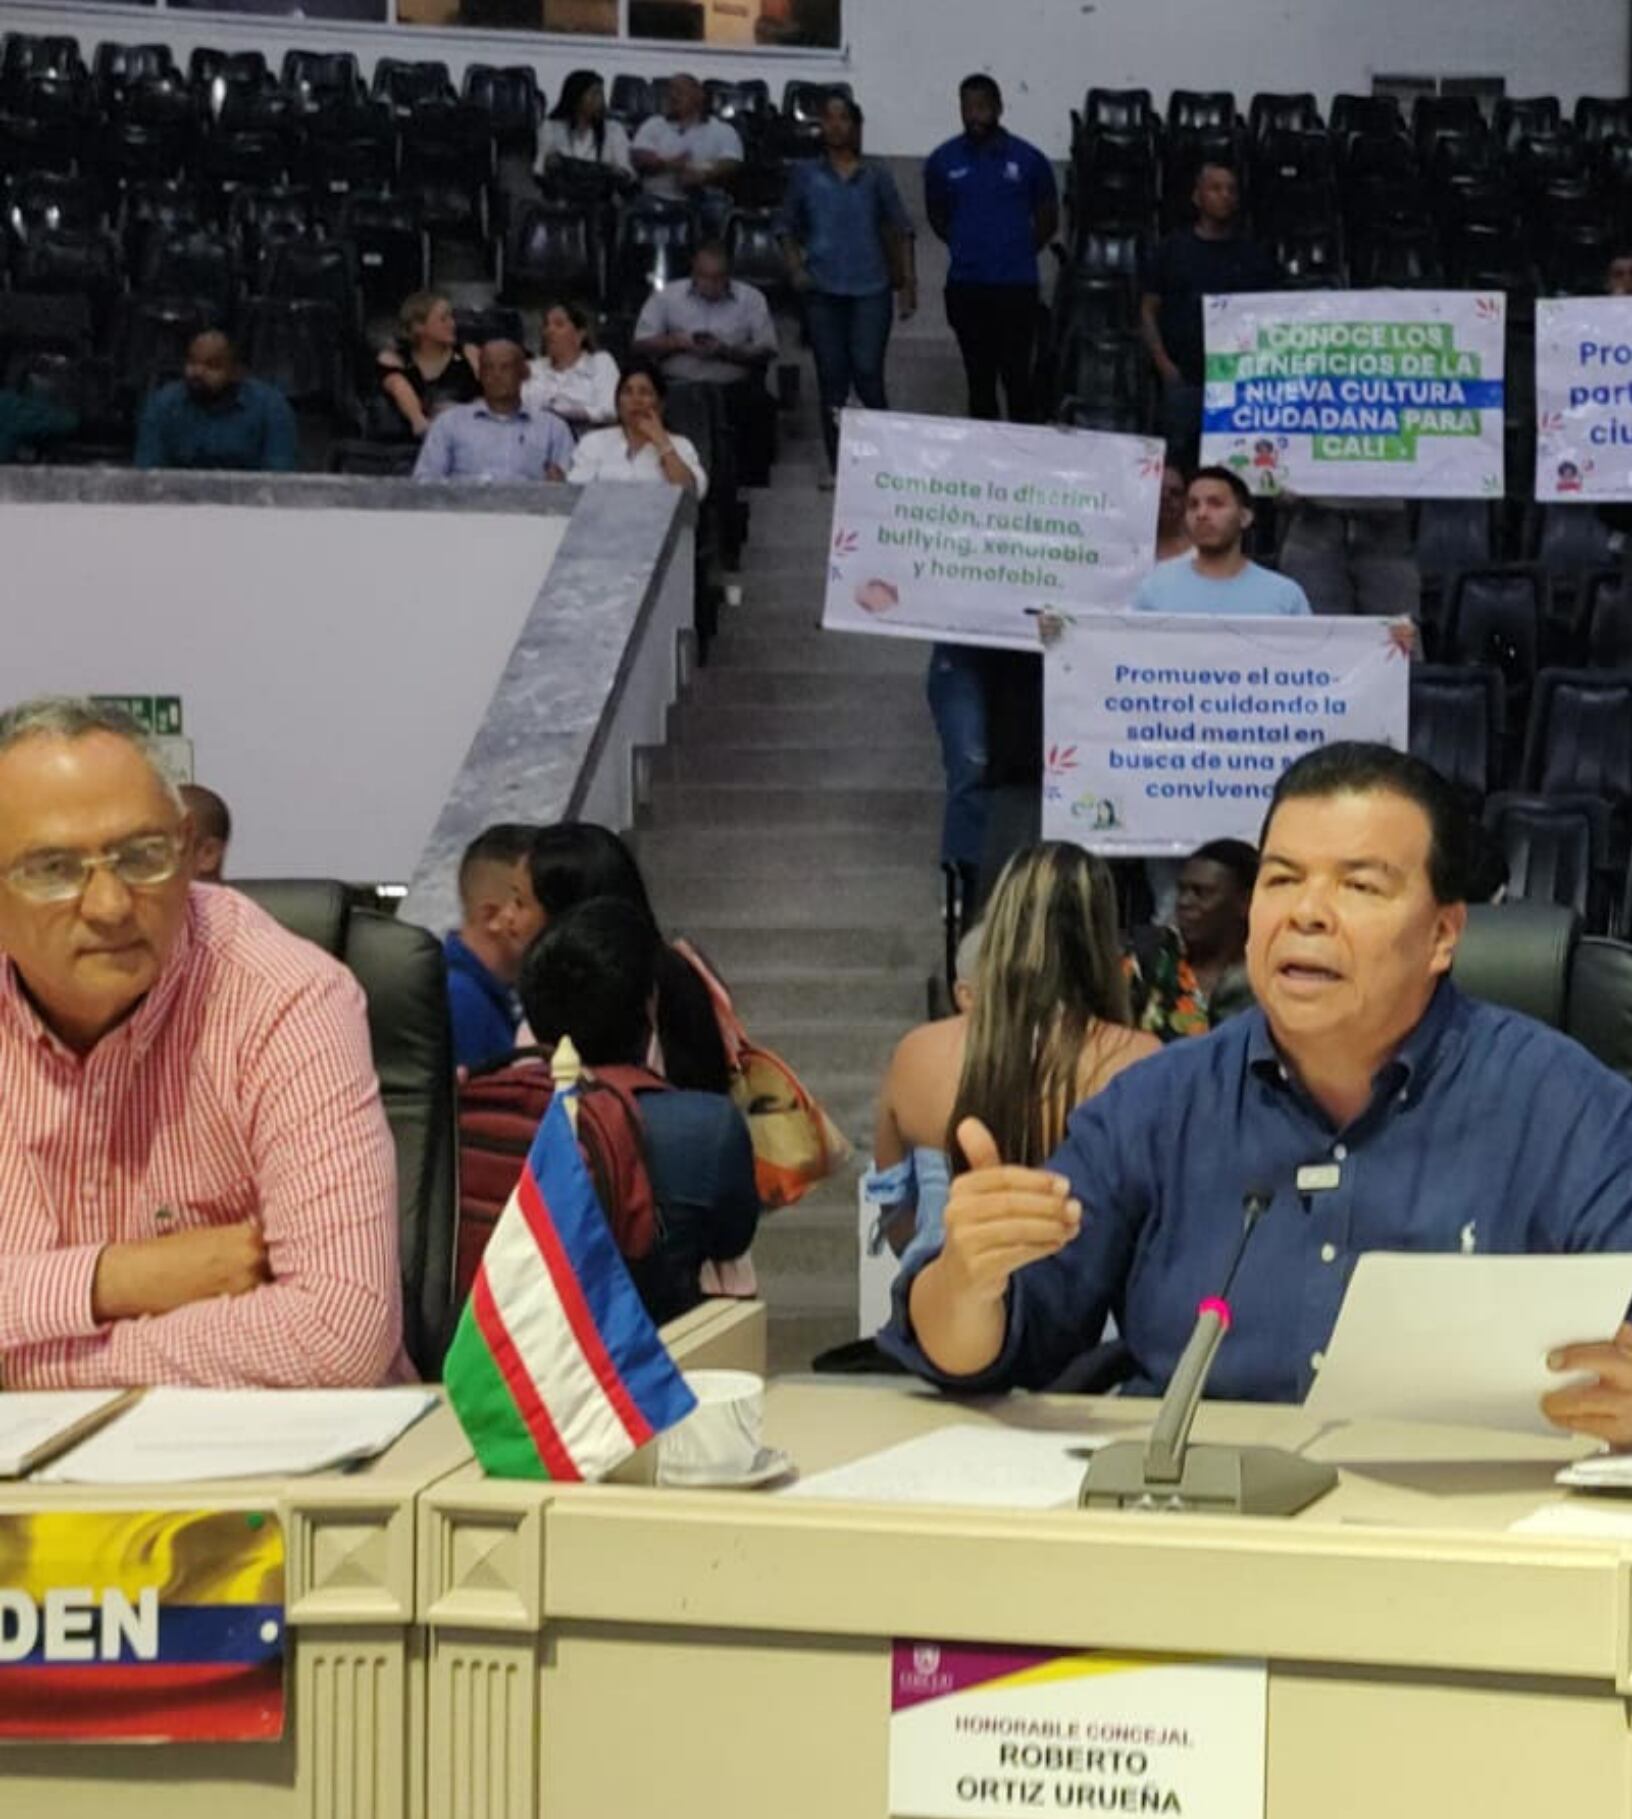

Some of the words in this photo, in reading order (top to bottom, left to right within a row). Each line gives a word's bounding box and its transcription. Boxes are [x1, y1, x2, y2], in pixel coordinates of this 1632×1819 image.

[1267, 326, 1385, 348] CONOCE
[1393, 326, 1443, 347] LOS
[1401, 353, 1434, 375] DE
[1442, 353, 1474, 374] LA
[1245, 380, 1334, 403] NUEVA
[1341, 381, 1465, 403] CULTURA
[1232, 407, 1398, 430] CIUDADANA
[1404, 410, 1476, 430] PARA
[875, 471, 981, 499] Combate
[988, 481, 1008, 500] la
[913, 559, 925, 579] y
[931, 560, 1065, 588] homofobia.
[1115, 665, 1241, 686] Promueve
[1248, 667, 1269, 686] el
[1275, 670, 1340, 686] auto-
[1105, 695, 1194, 713] control
[1200, 695, 1318, 714] cuidando
[1325, 697, 1346, 714] la
[1127, 723, 1195, 742] salud
[1202, 724, 1289, 743] mental
[1295, 728, 1325, 742] en
[1109, 749, 1184, 769] busca
[1191, 750, 1222, 769] de
[1229, 754, 1274, 769] una
[1145, 779, 1276, 799] convivenc
[955, 1714, 1080, 1739] HONORABLE
[1086, 1721, 1193, 1747] CONCEJAL
[999, 1744, 1148, 1775] ROBERTO
[956, 1777, 1044, 1804] ORTIZ
[1055, 1781, 1181, 1813] URUEÑA
